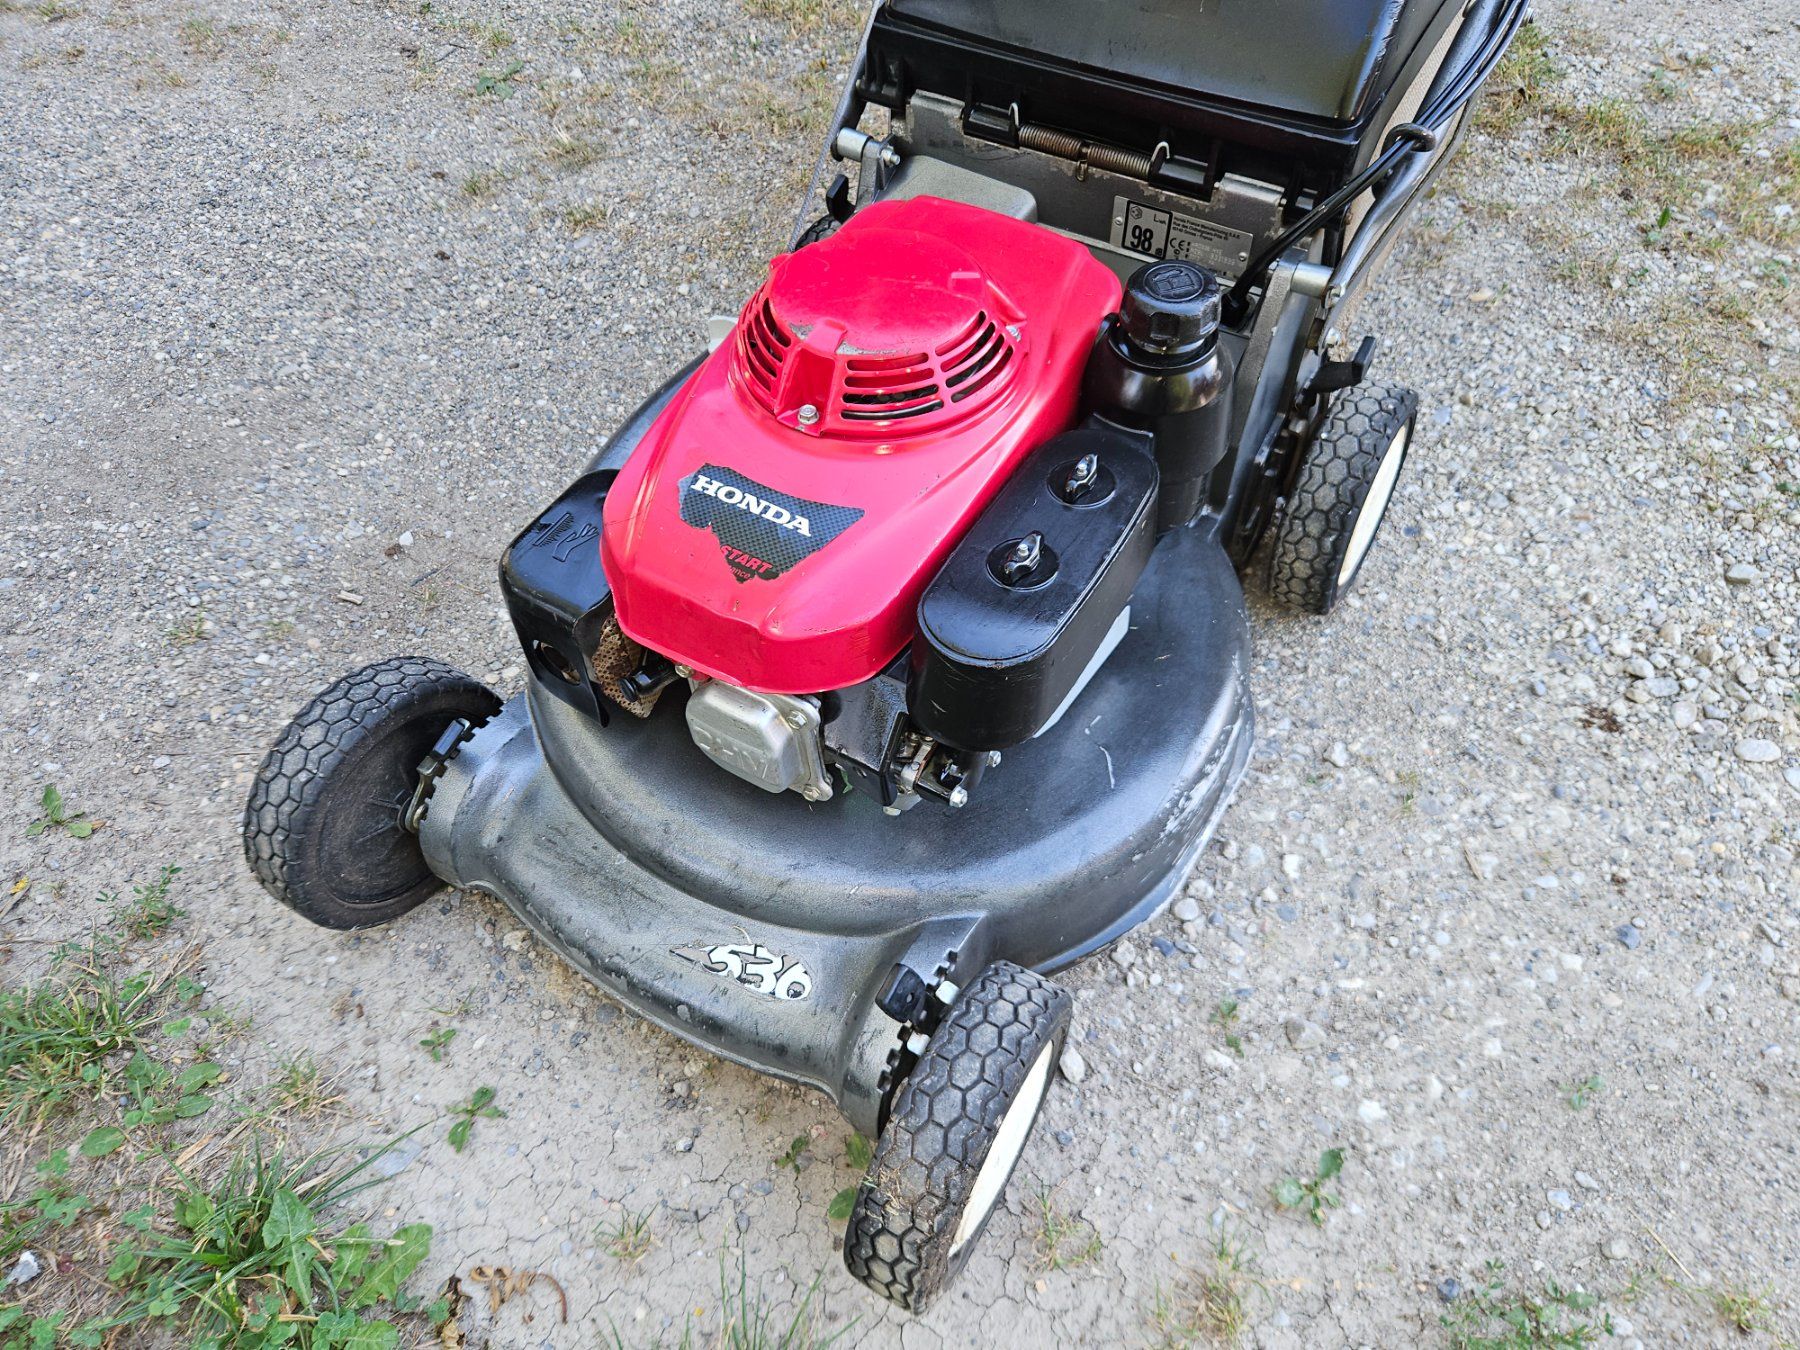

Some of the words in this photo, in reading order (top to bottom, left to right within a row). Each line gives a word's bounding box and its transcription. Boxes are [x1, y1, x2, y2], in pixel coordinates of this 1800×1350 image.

[1130, 224, 1154, 252] 98
[690, 474, 812, 537] HONDA
[720, 544, 773, 573] START
[700, 944, 813, 1000] 536
